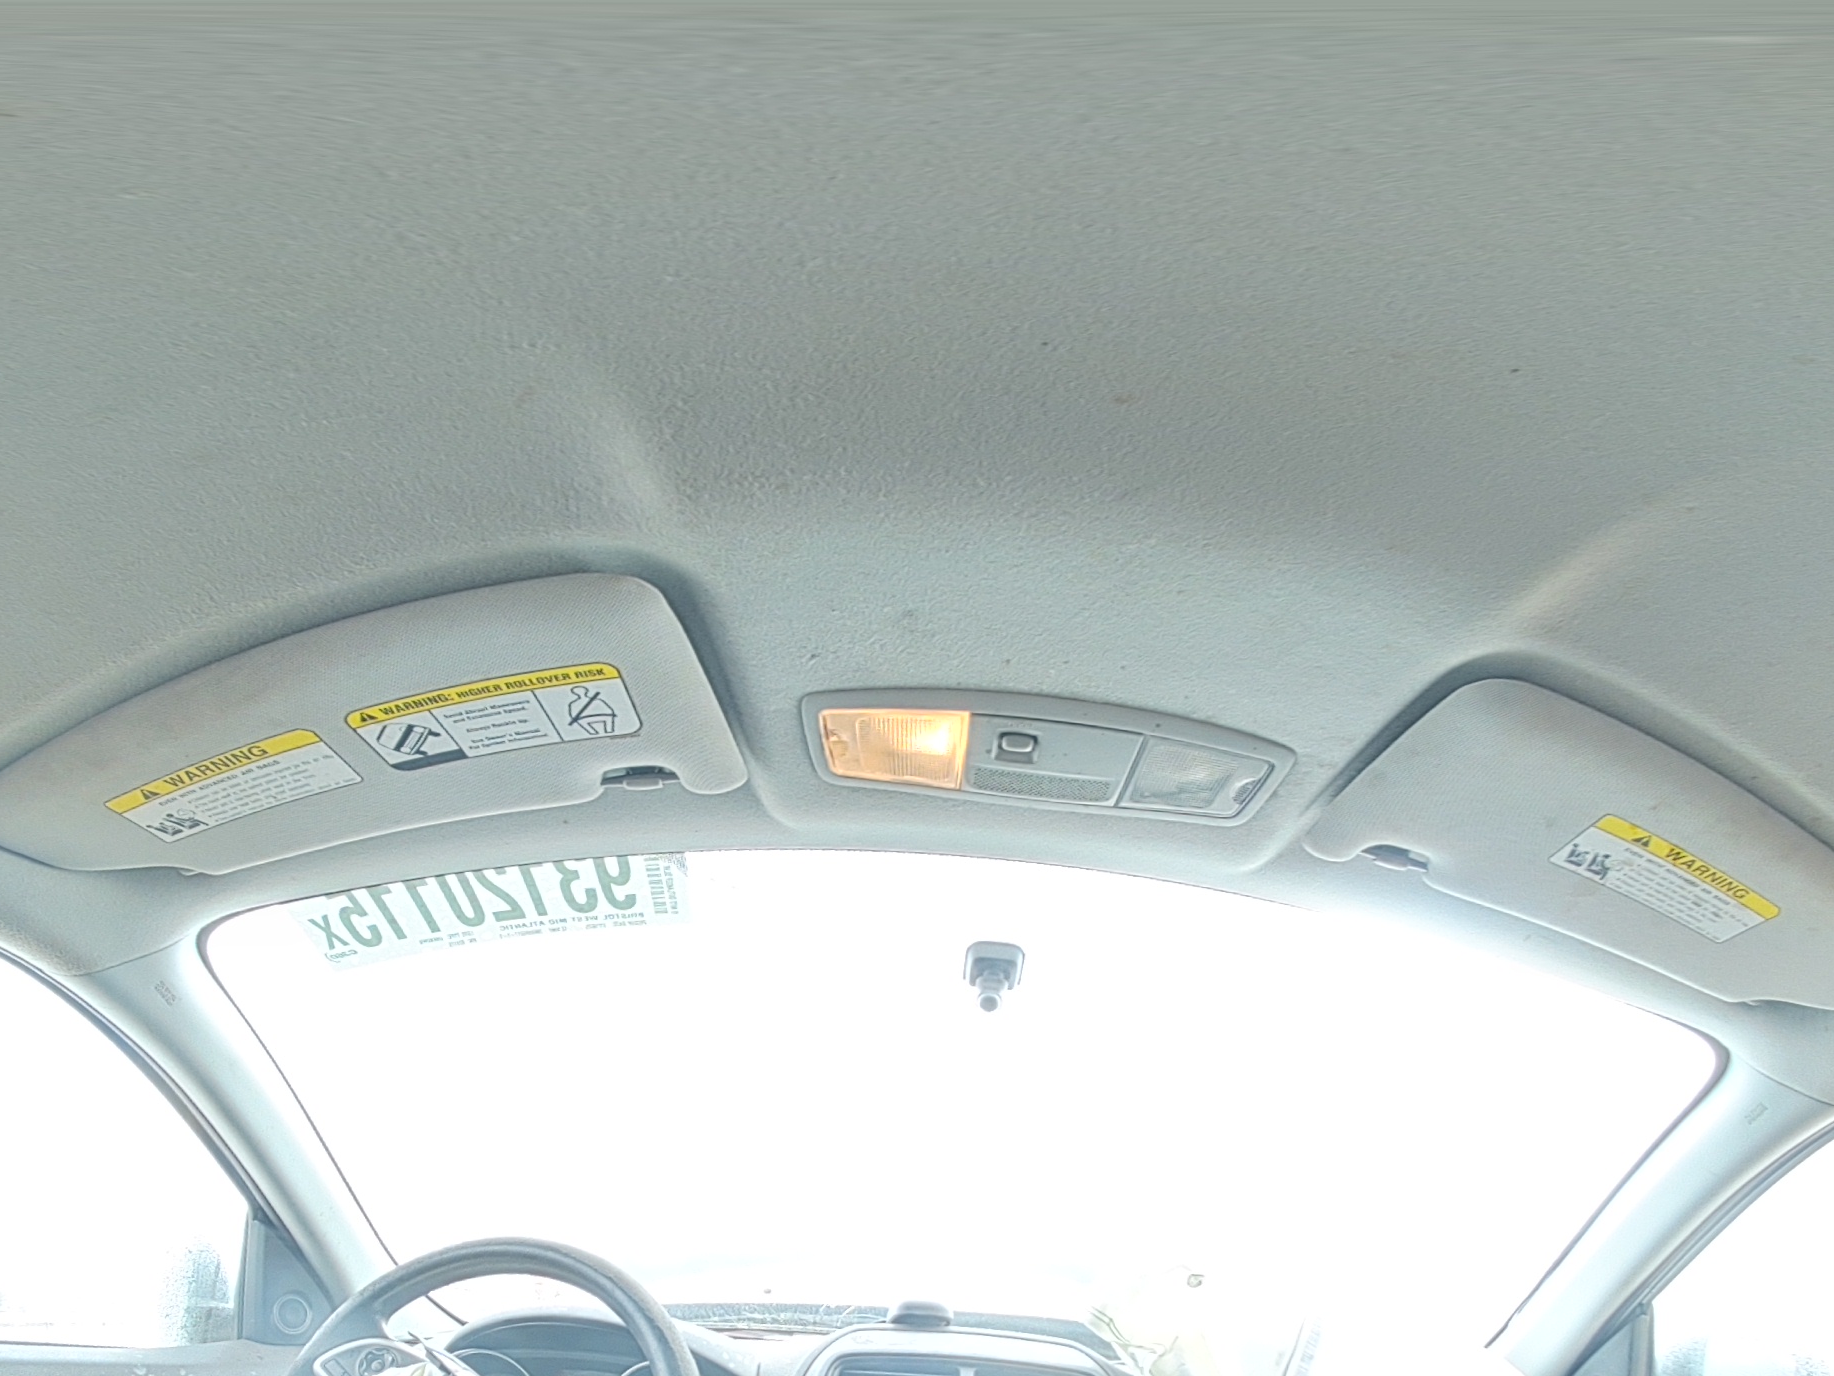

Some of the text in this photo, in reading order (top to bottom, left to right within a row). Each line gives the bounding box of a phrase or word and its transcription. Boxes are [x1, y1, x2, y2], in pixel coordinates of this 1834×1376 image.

[378, 667, 607, 717] WARNING: HIGHER ROLLOVER RISK
[163, 744, 270, 788] WARNING
[199, 773, 239, 791] ADVANCED
[1665, 847, 1750, 900] WARNING
